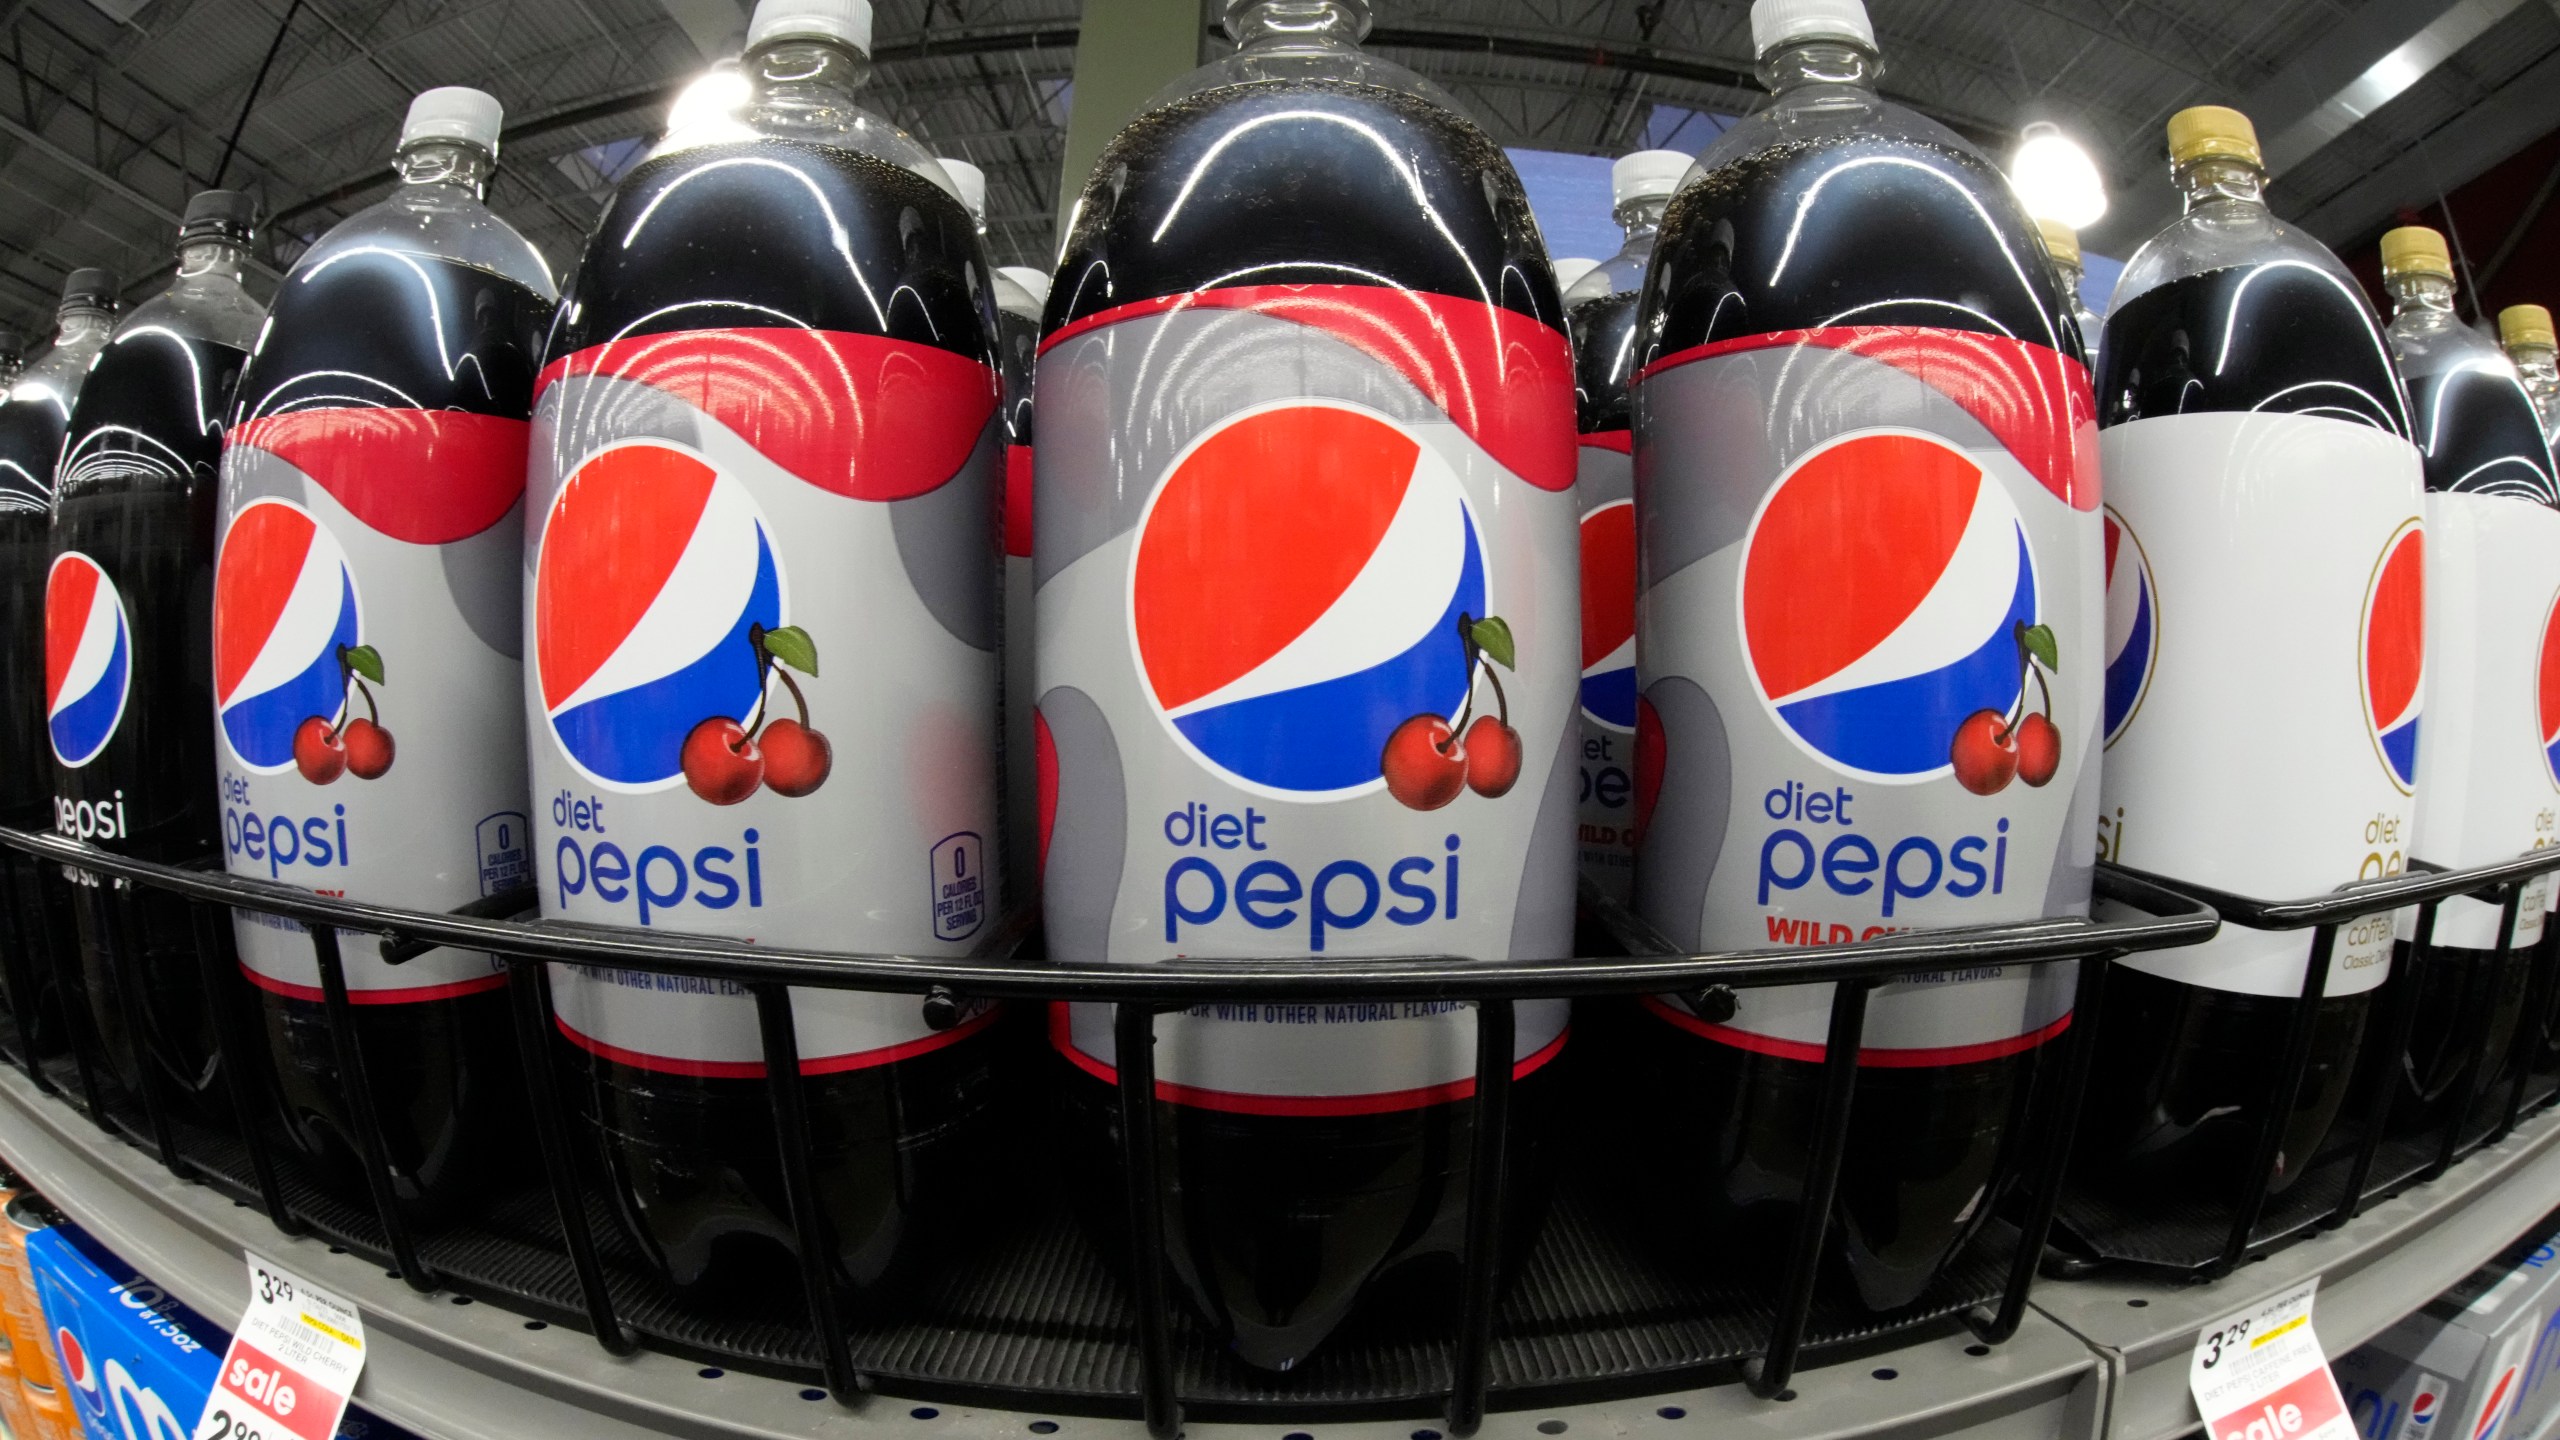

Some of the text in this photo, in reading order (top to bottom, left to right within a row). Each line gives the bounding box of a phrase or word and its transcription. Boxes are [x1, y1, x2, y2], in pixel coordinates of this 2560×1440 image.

[224, 770, 251, 806] diet
[1764, 780, 1853, 825] diet
[553, 789, 605, 833] diet
[1164, 801, 1267, 851] diet
[226, 803, 348, 880] pepsi
[498, 823, 510, 850] 0
[2365, 813, 2400, 844] diet
[556, 827, 762, 926] pepsi
[954, 846, 965, 878] 0
[1757, 817, 2009, 918] pepsi
[942, 876, 977, 899] CALORIES
[1164, 833, 1460, 952] pepsi
[937, 900, 952, 917] PER
[952, 898, 963, 912] 12
[964, 896, 973, 910] FL
[946, 908, 977, 931] SERVING
[1766, 916, 1854, 946] WILD
[616, 968, 653, 990] OTHER
[656, 975, 715, 995] NATURAL
[1216, 1004, 1257, 1023] WITH
[1264, 1005, 1317, 1025] OTHER
[1325, 1003, 1396, 1024] NATURAL
[252, 1317, 270, 1333] DIET
[271, 1327, 291, 1346] PEPSI
[292, 1338, 312, 1355] WILD
[312, 1351, 349, 1373] CHERRY
[285, 1346, 308, 1365] LITER
[229, 1358, 296, 1416] sale
